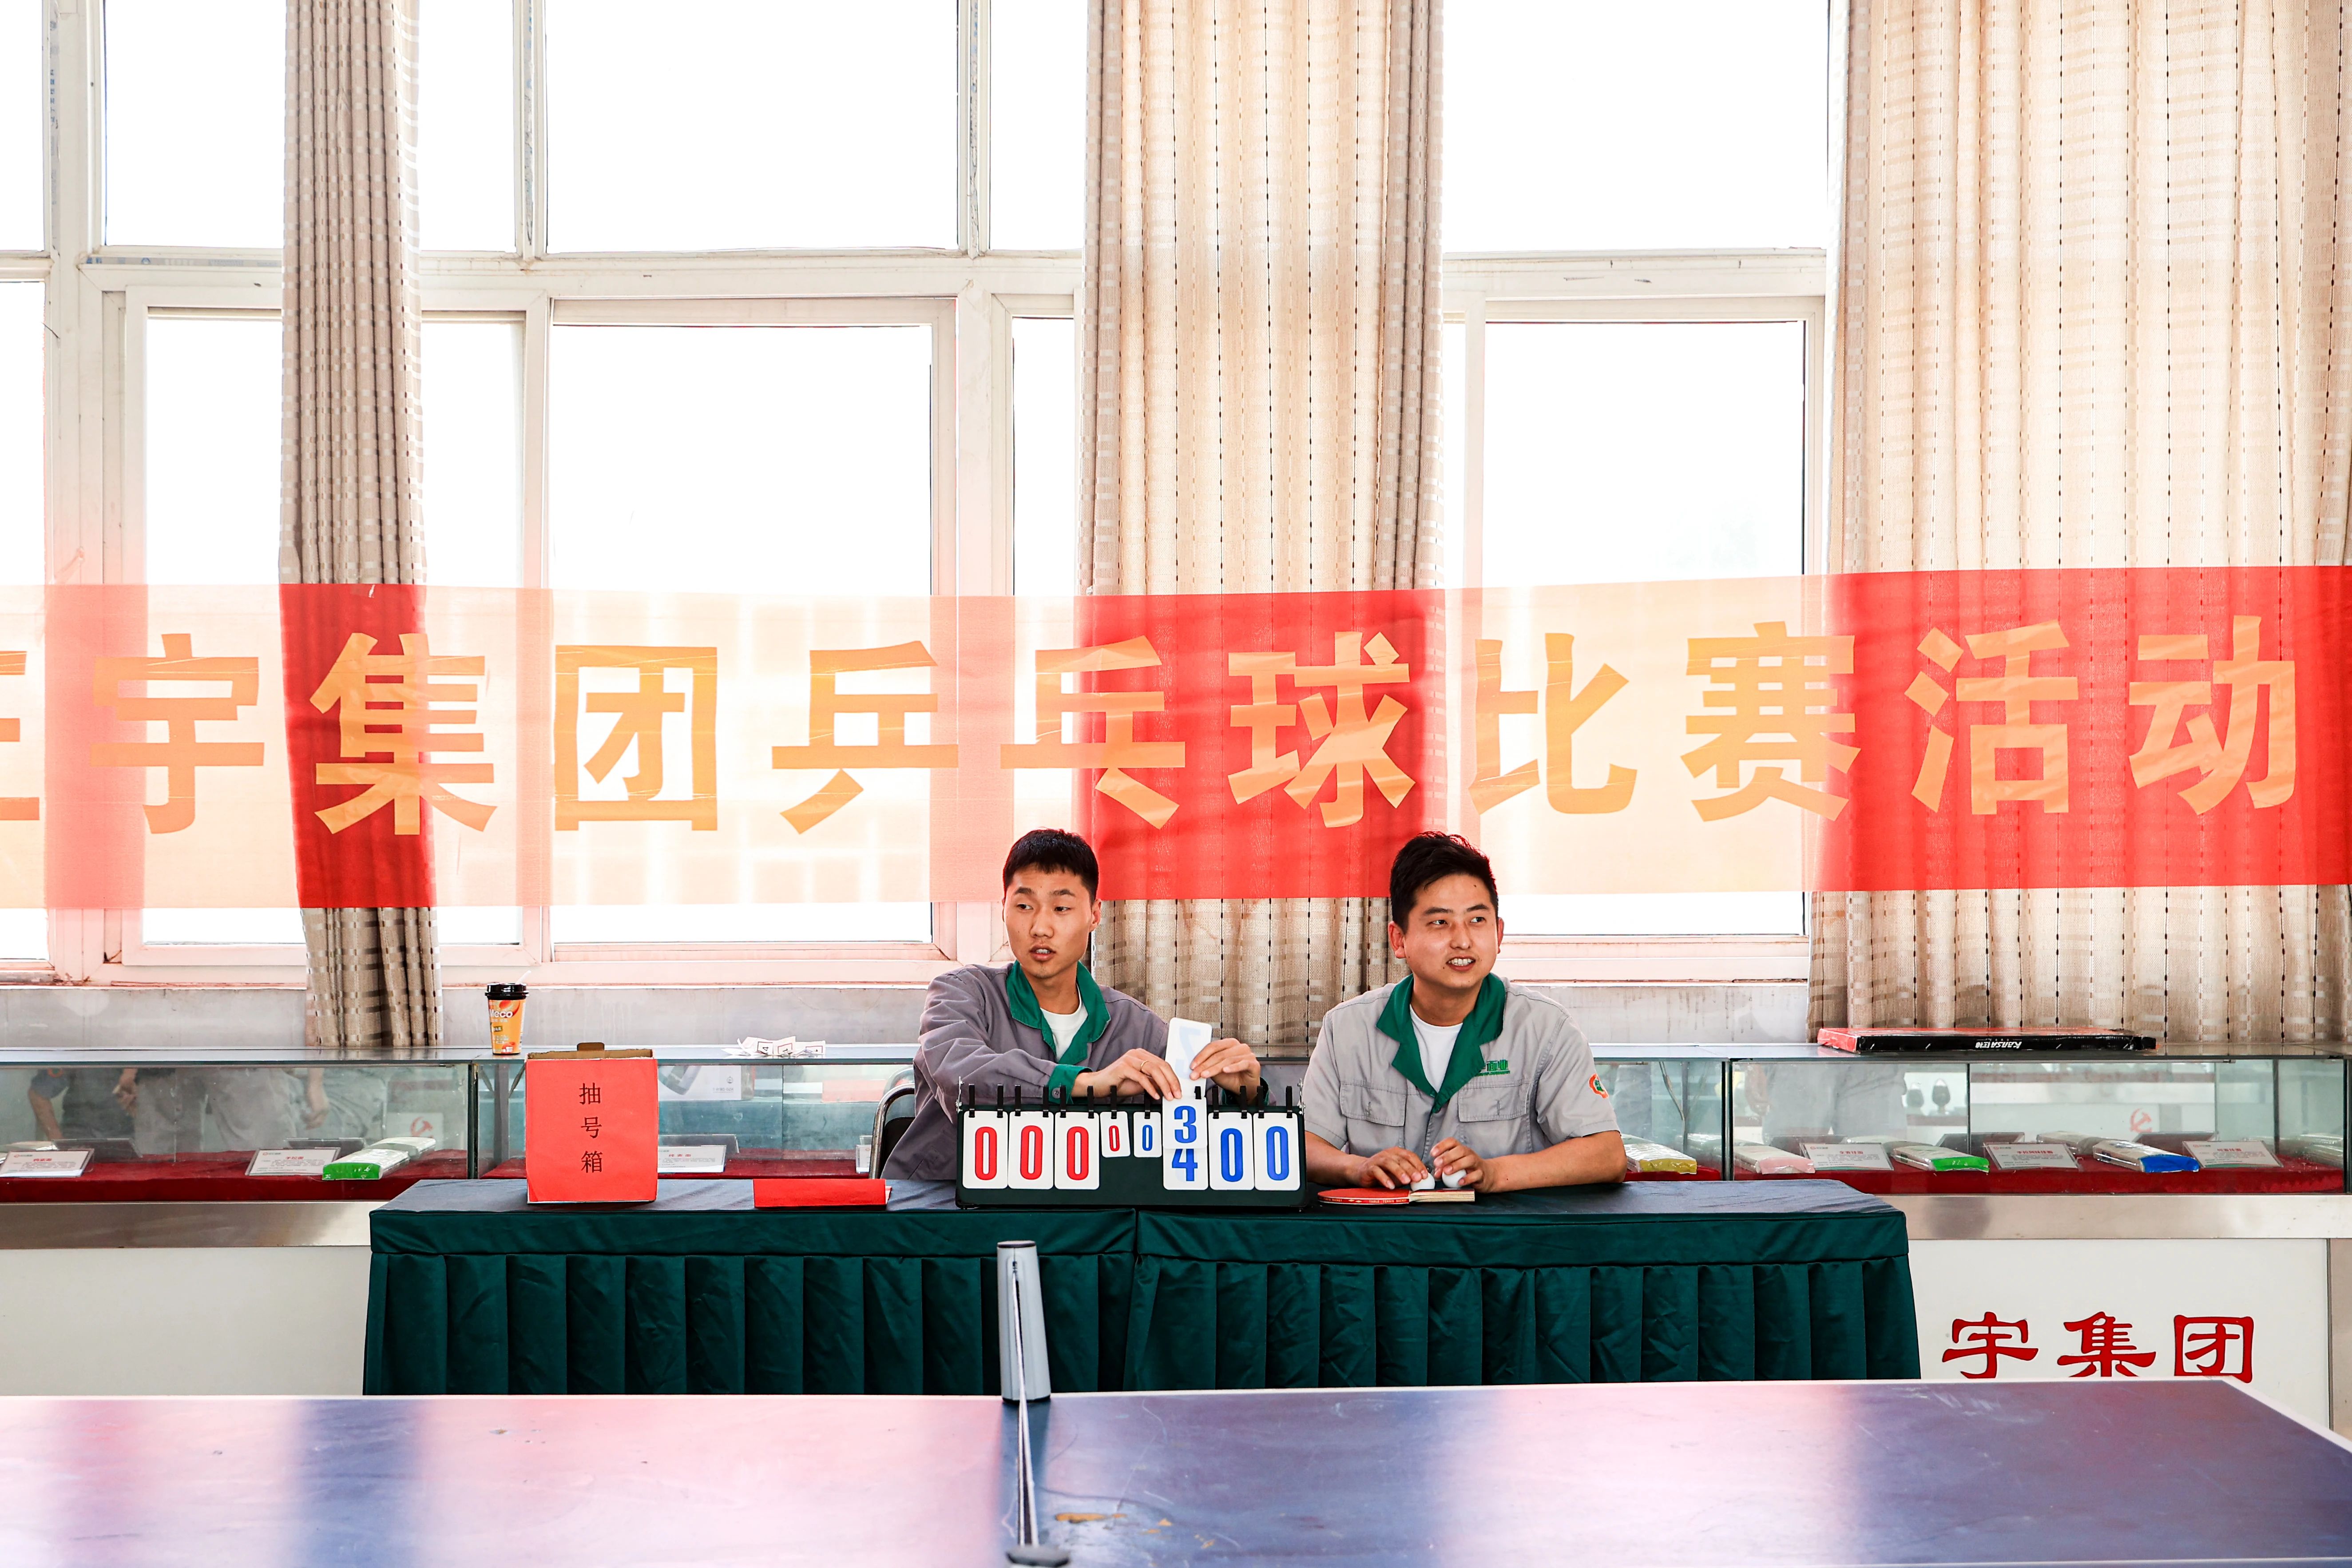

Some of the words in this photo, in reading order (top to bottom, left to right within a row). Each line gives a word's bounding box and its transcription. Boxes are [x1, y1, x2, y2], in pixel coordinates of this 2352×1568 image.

[0, 615, 2296, 834] 宇集团乒乓球比赛活动
[579, 1082, 603, 1173] 抽号箱
[975, 1127, 997, 1180] 0
[1020, 1125, 1043, 1180] 0
[1067, 1126, 1089, 1181] 0
[1109, 1125, 1120, 1151] 0
[1142, 1124, 1153, 1151] 0
[1172, 1149, 1198, 1182] 4
[1221, 1128, 1243, 1182] 0
[1266, 1126, 1289, 1181] 0
[1174, 1105, 1198, 1143] 3
[1943, 1311, 2254, 1384] 宇集团
